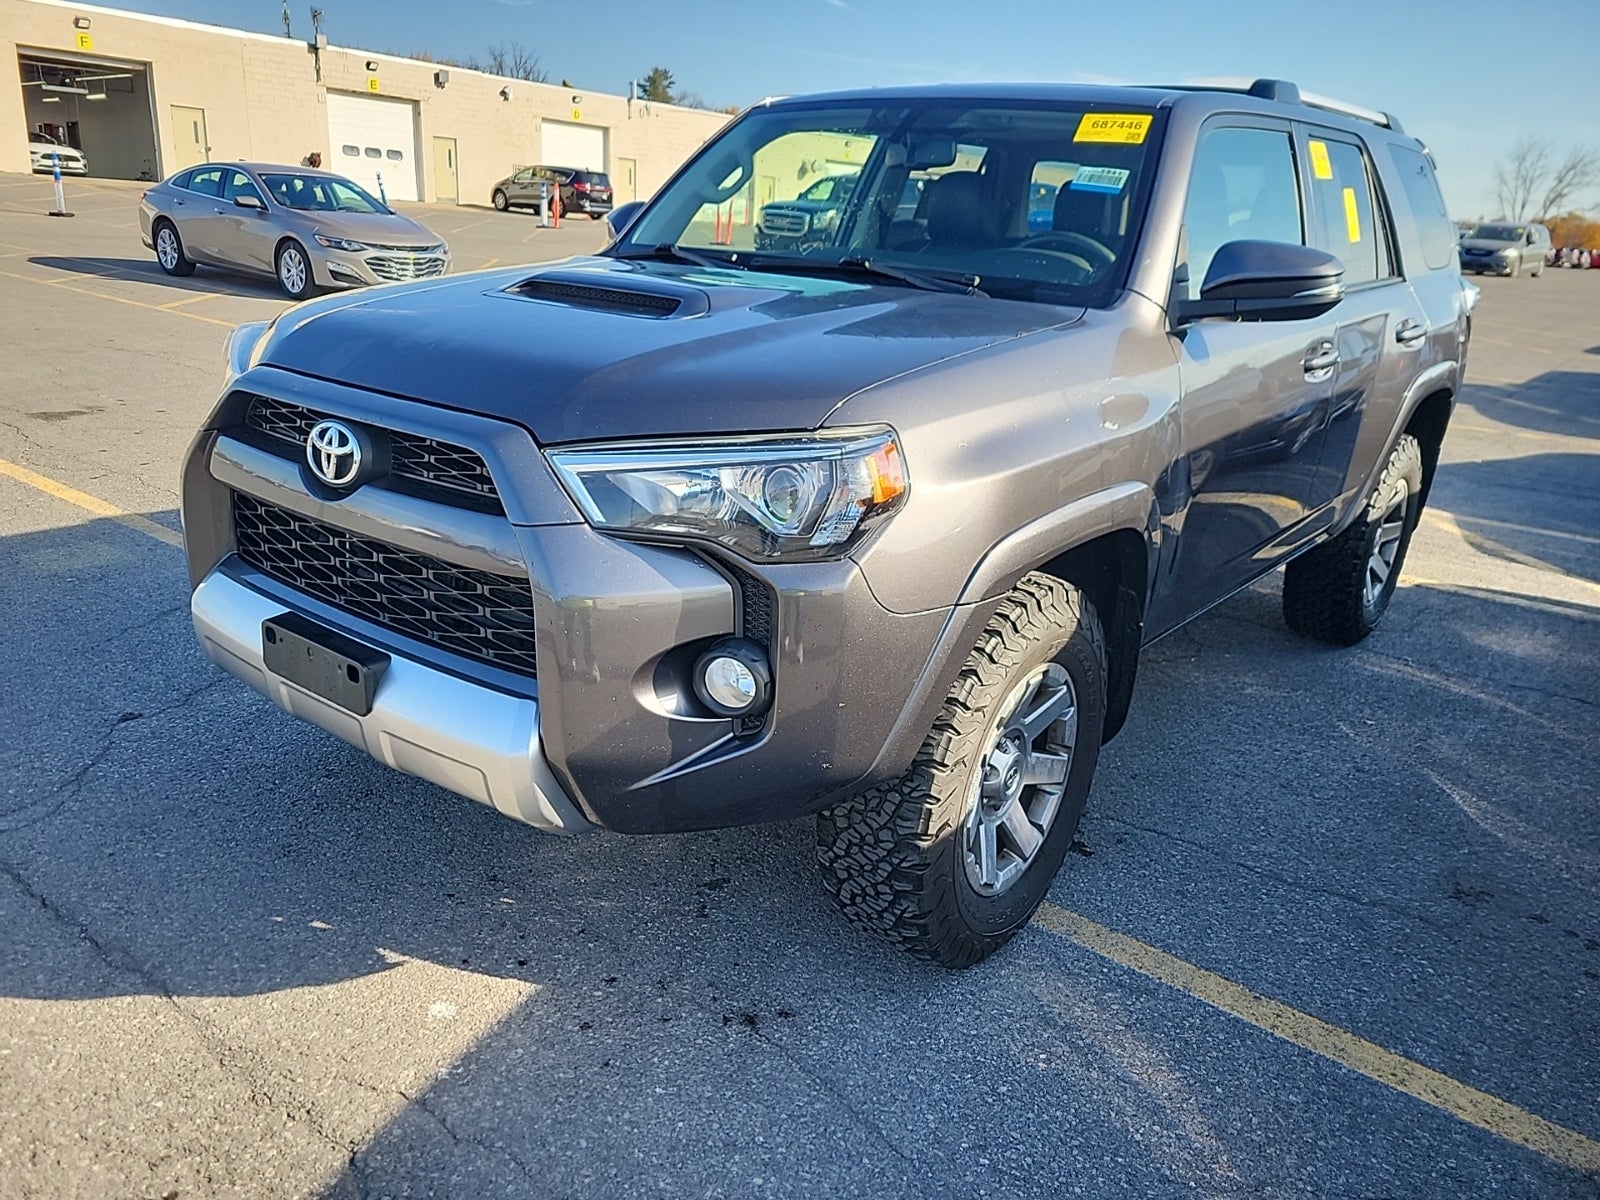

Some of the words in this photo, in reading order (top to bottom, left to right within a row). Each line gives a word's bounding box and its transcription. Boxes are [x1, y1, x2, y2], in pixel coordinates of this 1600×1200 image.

[79, 35, 89, 47] F
[370, 79, 377, 90] E
[574, 110, 580, 119] D
[1091, 119, 1143, 130] 687446
